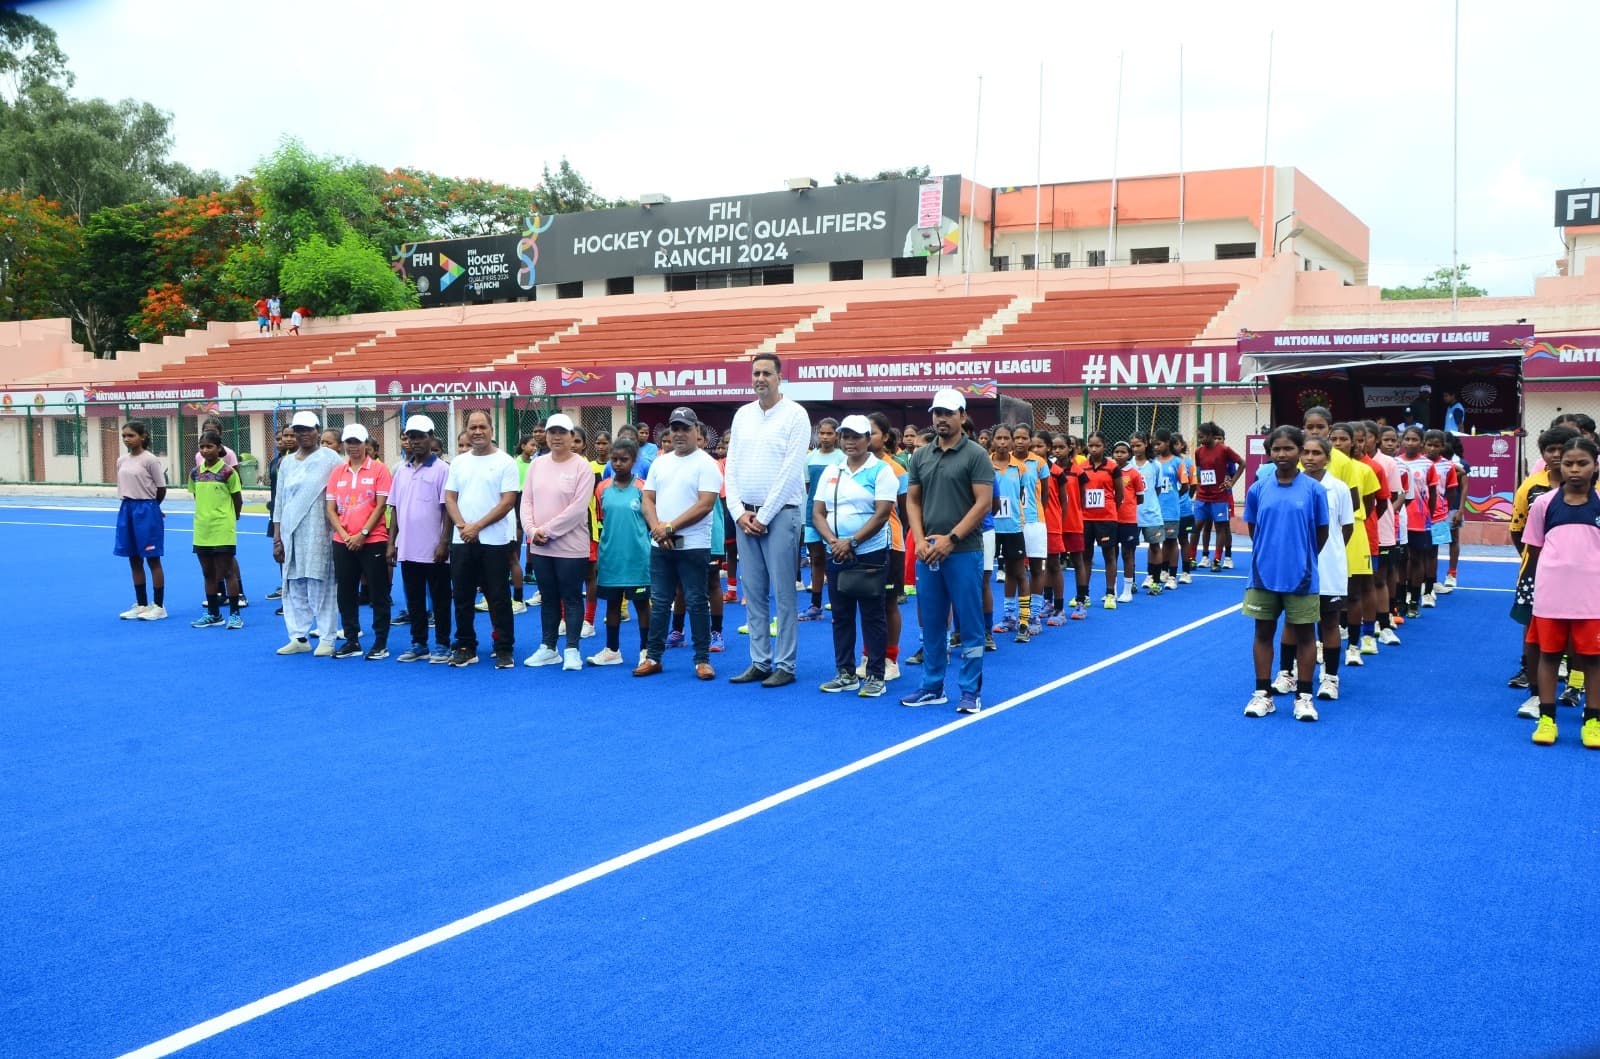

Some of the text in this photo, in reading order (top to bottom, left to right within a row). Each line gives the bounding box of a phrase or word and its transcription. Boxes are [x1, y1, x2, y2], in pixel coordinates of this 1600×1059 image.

[708, 200, 742, 221] FIH
[573, 210, 887, 255] HOCKEY OLYMPIC QUALIFIERS
[412, 252, 433, 267] FIH
[467, 253, 505, 266] HOCKEY
[654, 241, 789, 269] RANCHI 2024
[467, 263, 509, 276] OLYMPIC
[1274, 331, 1490, 346] NATIONAL WOMEN'S HOCKEY LEAGUE
[798, 358, 1052, 379] NATIONAL WOMEN'S HOCKEY LEAGUE
[1081, 352, 1267, 390] #NWHL
[95, 388, 205, 401] NATIONAL WOMEN'S HOCKEY LEAGUE
[410, 380, 520, 401] HOCKEY INDIA
[1201, 471, 1214, 482] 302
[1467, 465, 1499, 478] GUE
[1087, 491, 1102, 505] 307
